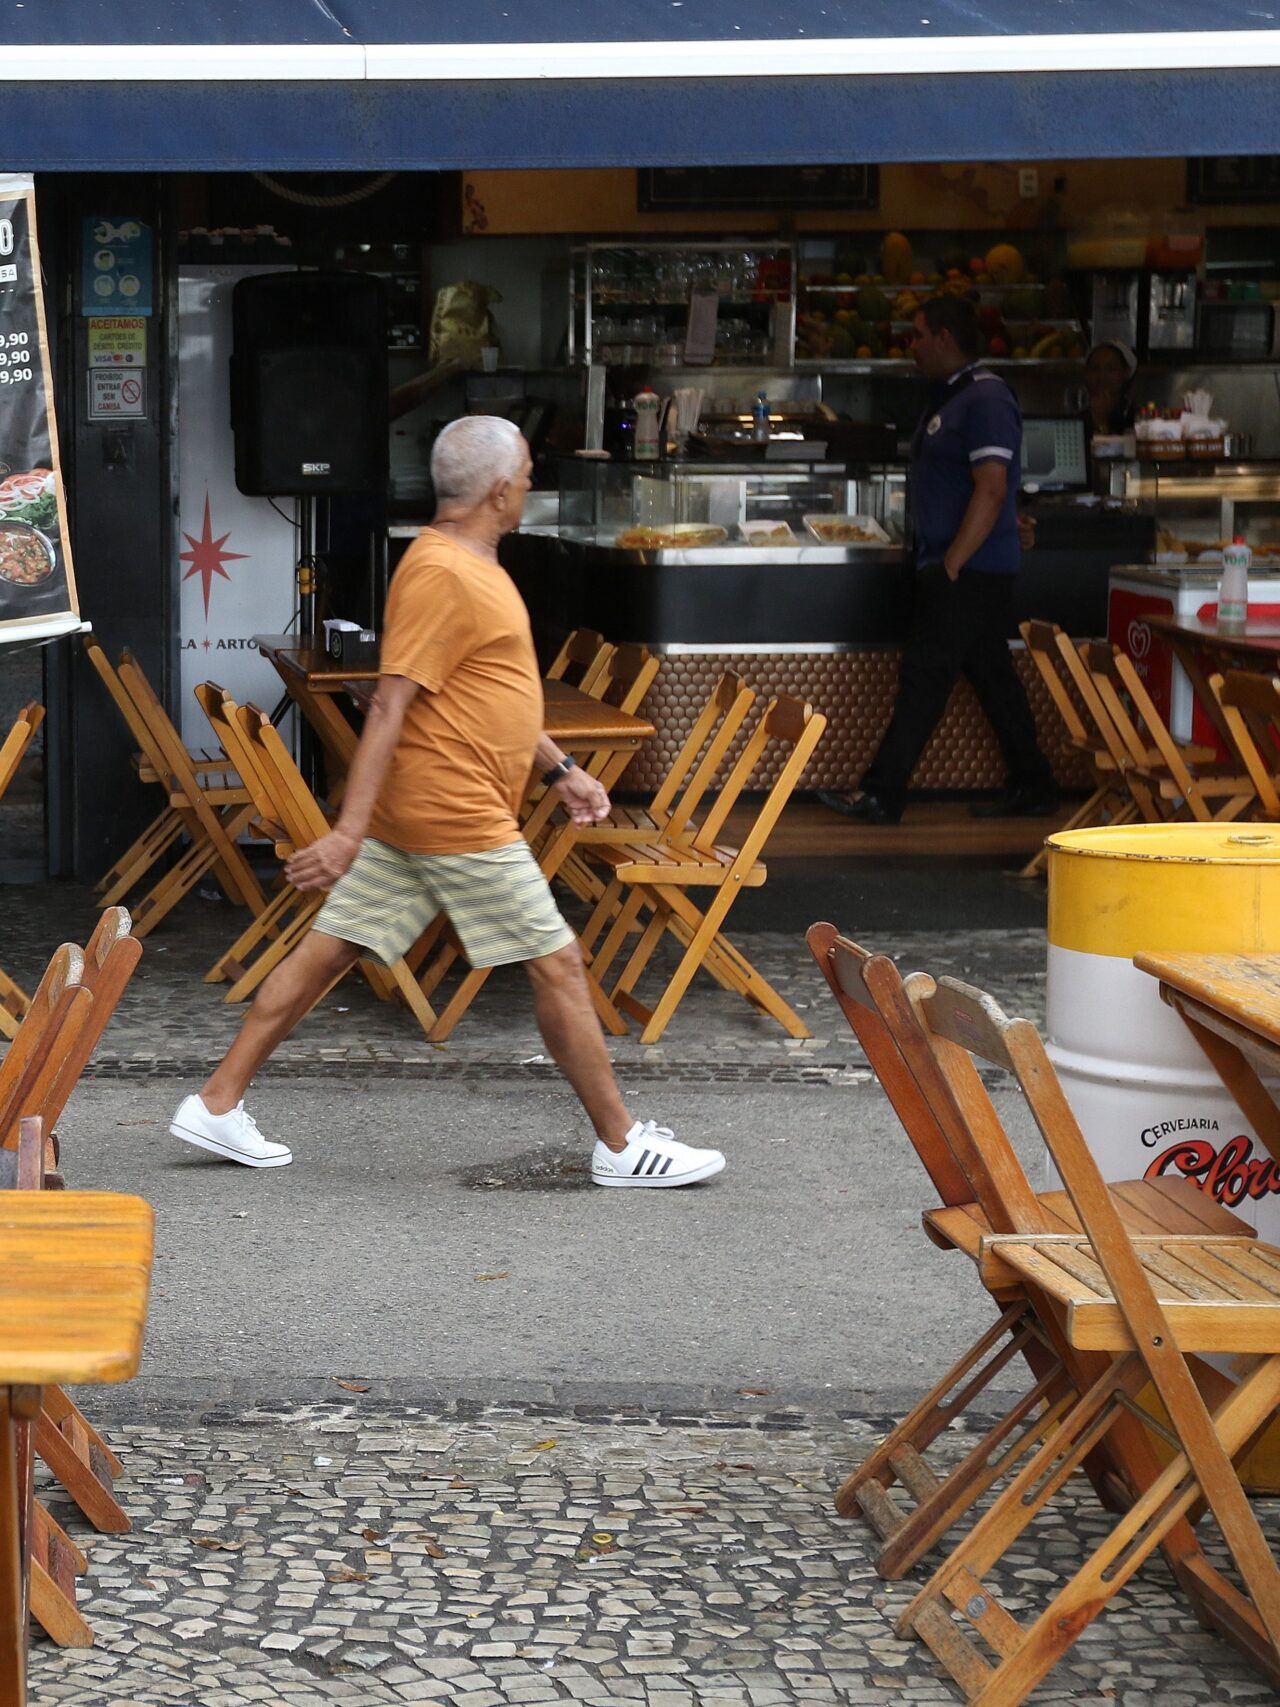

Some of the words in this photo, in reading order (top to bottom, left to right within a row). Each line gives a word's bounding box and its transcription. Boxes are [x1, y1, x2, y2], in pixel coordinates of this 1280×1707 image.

[90, 318, 144, 329] ACEITAMOS
[97, 383, 122, 391] ENTRAR
[103, 392, 116, 400] SEM
[98, 402, 121, 410] CAMISA
[1140, 1118, 1219, 1148] CERVEJARIA
